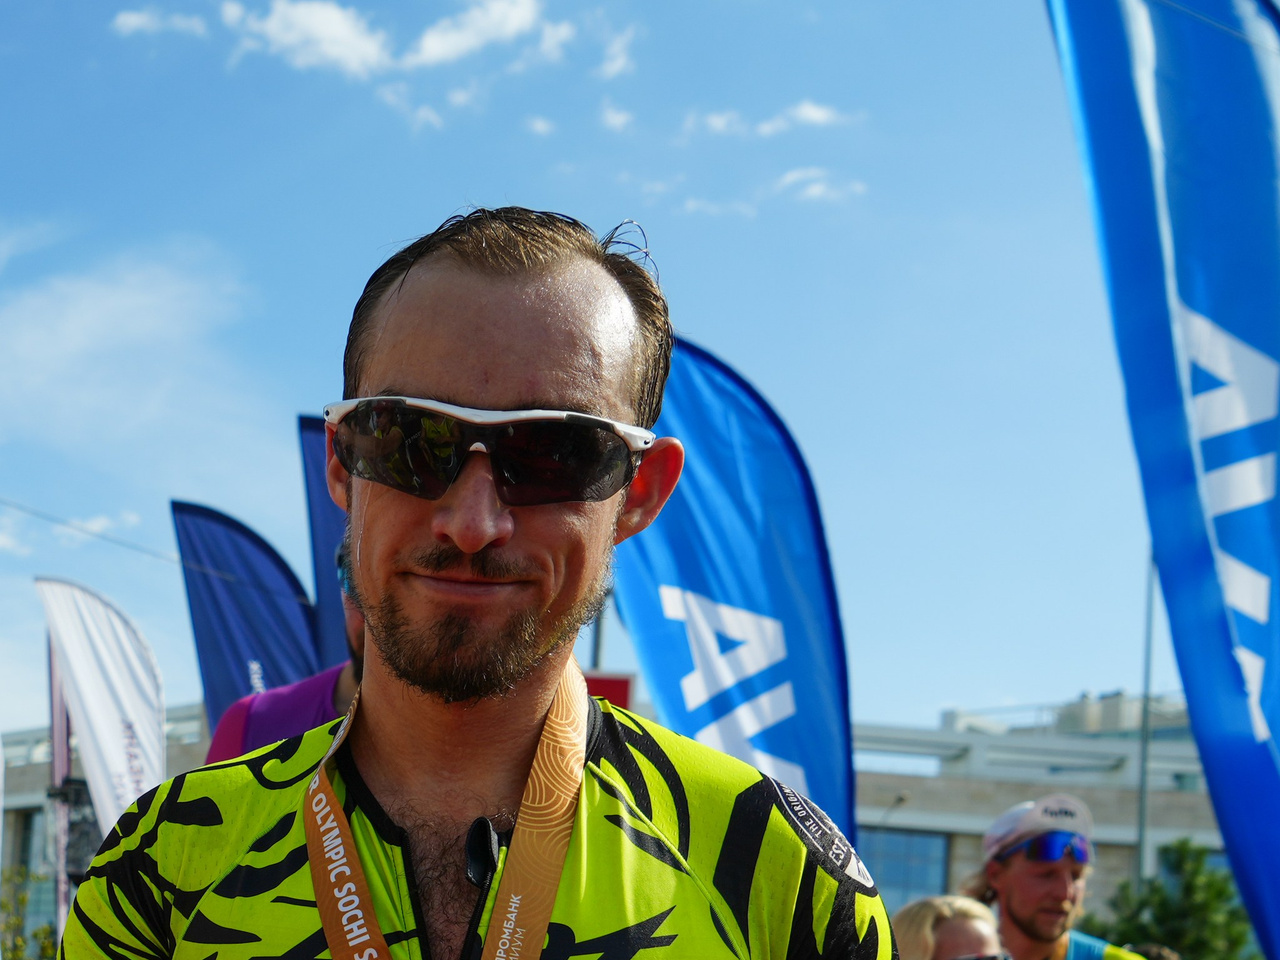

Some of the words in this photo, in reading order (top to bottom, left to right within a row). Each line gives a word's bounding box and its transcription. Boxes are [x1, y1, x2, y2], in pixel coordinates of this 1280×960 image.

[312, 792, 350, 882] OLYMPIC
[333, 883, 370, 947] SOCHI
[805, 820, 822, 838] THE
